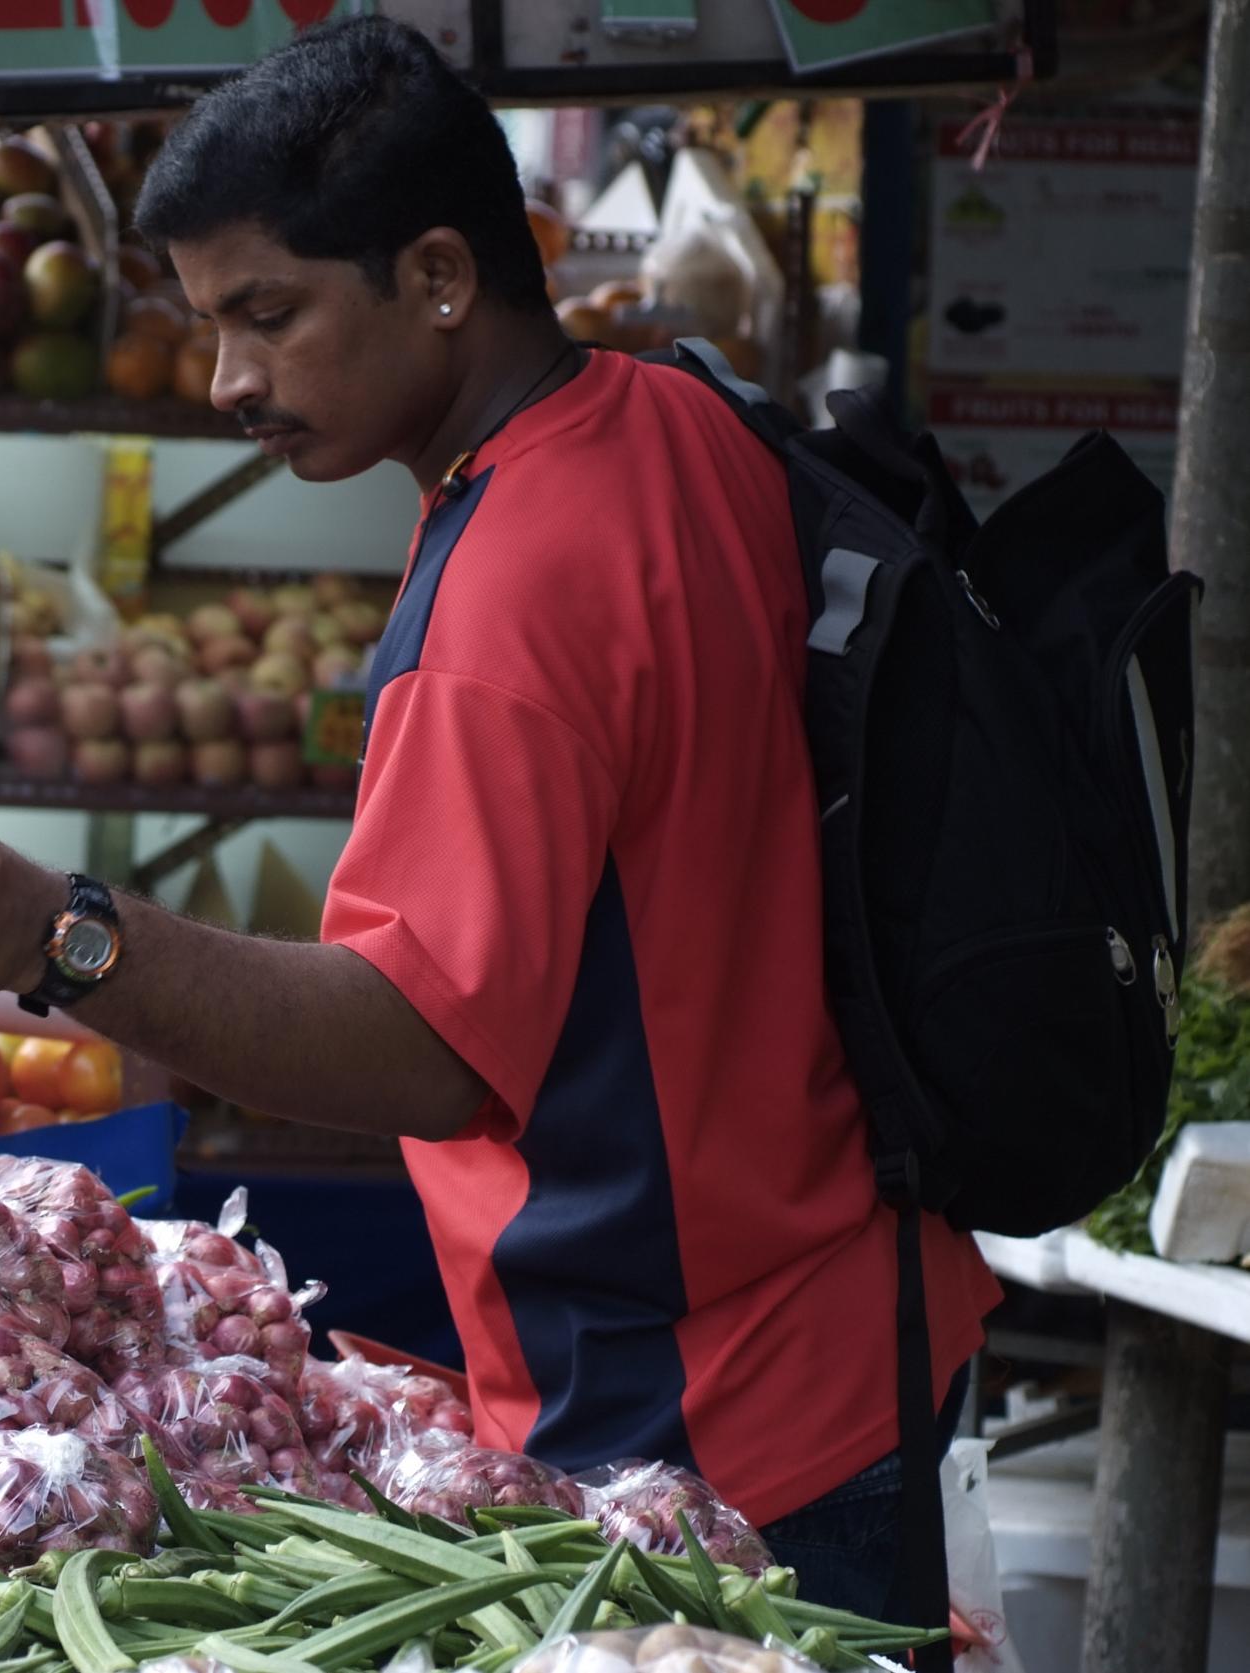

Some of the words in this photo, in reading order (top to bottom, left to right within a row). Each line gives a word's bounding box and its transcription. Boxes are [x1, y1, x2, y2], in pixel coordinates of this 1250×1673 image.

[1066, 134, 1118, 154] FOR
[953, 397, 1049, 420] FRUITS
[1057, 399, 1108, 421] FOR
[1118, 401, 1177, 424] HEA
